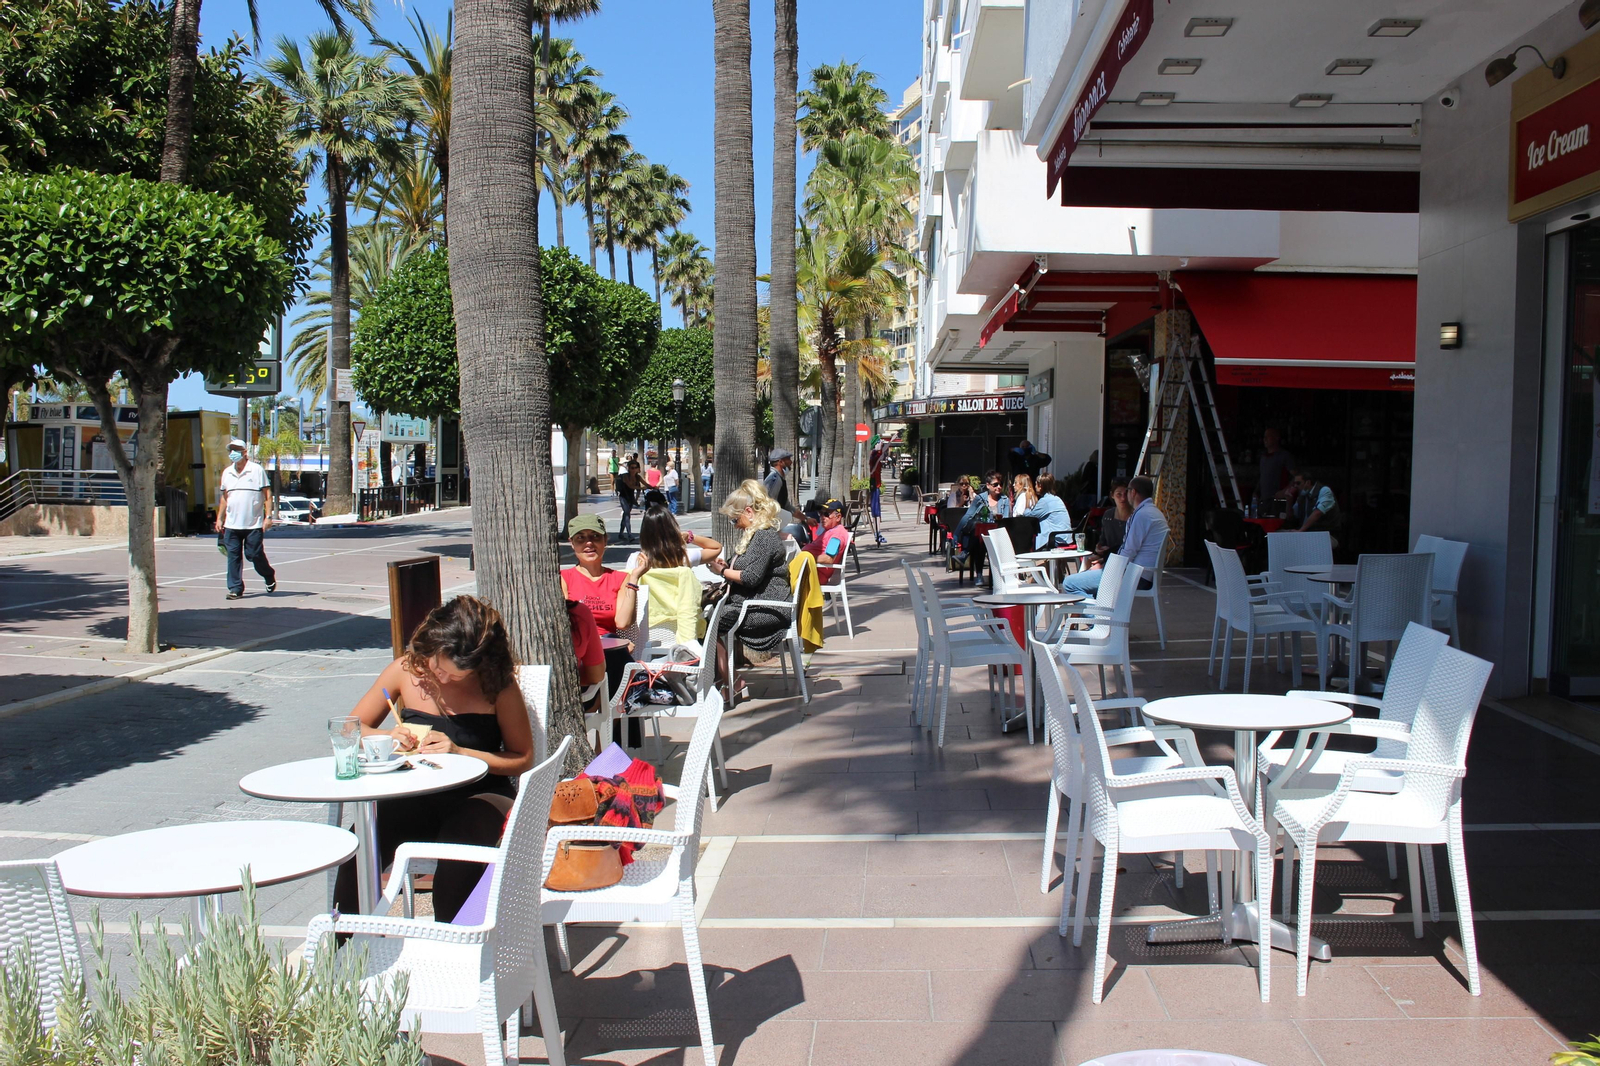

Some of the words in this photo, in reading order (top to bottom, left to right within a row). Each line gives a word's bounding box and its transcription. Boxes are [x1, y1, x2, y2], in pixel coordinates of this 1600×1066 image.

[1527, 140, 1546, 171] Ice
[1547, 123, 1589, 162] Cream
[957, 399, 985, 411] SALON
[986, 398, 999, 411] DE
[40, 407, 49, 419] fly
[49, 407, 62, 417] blue
